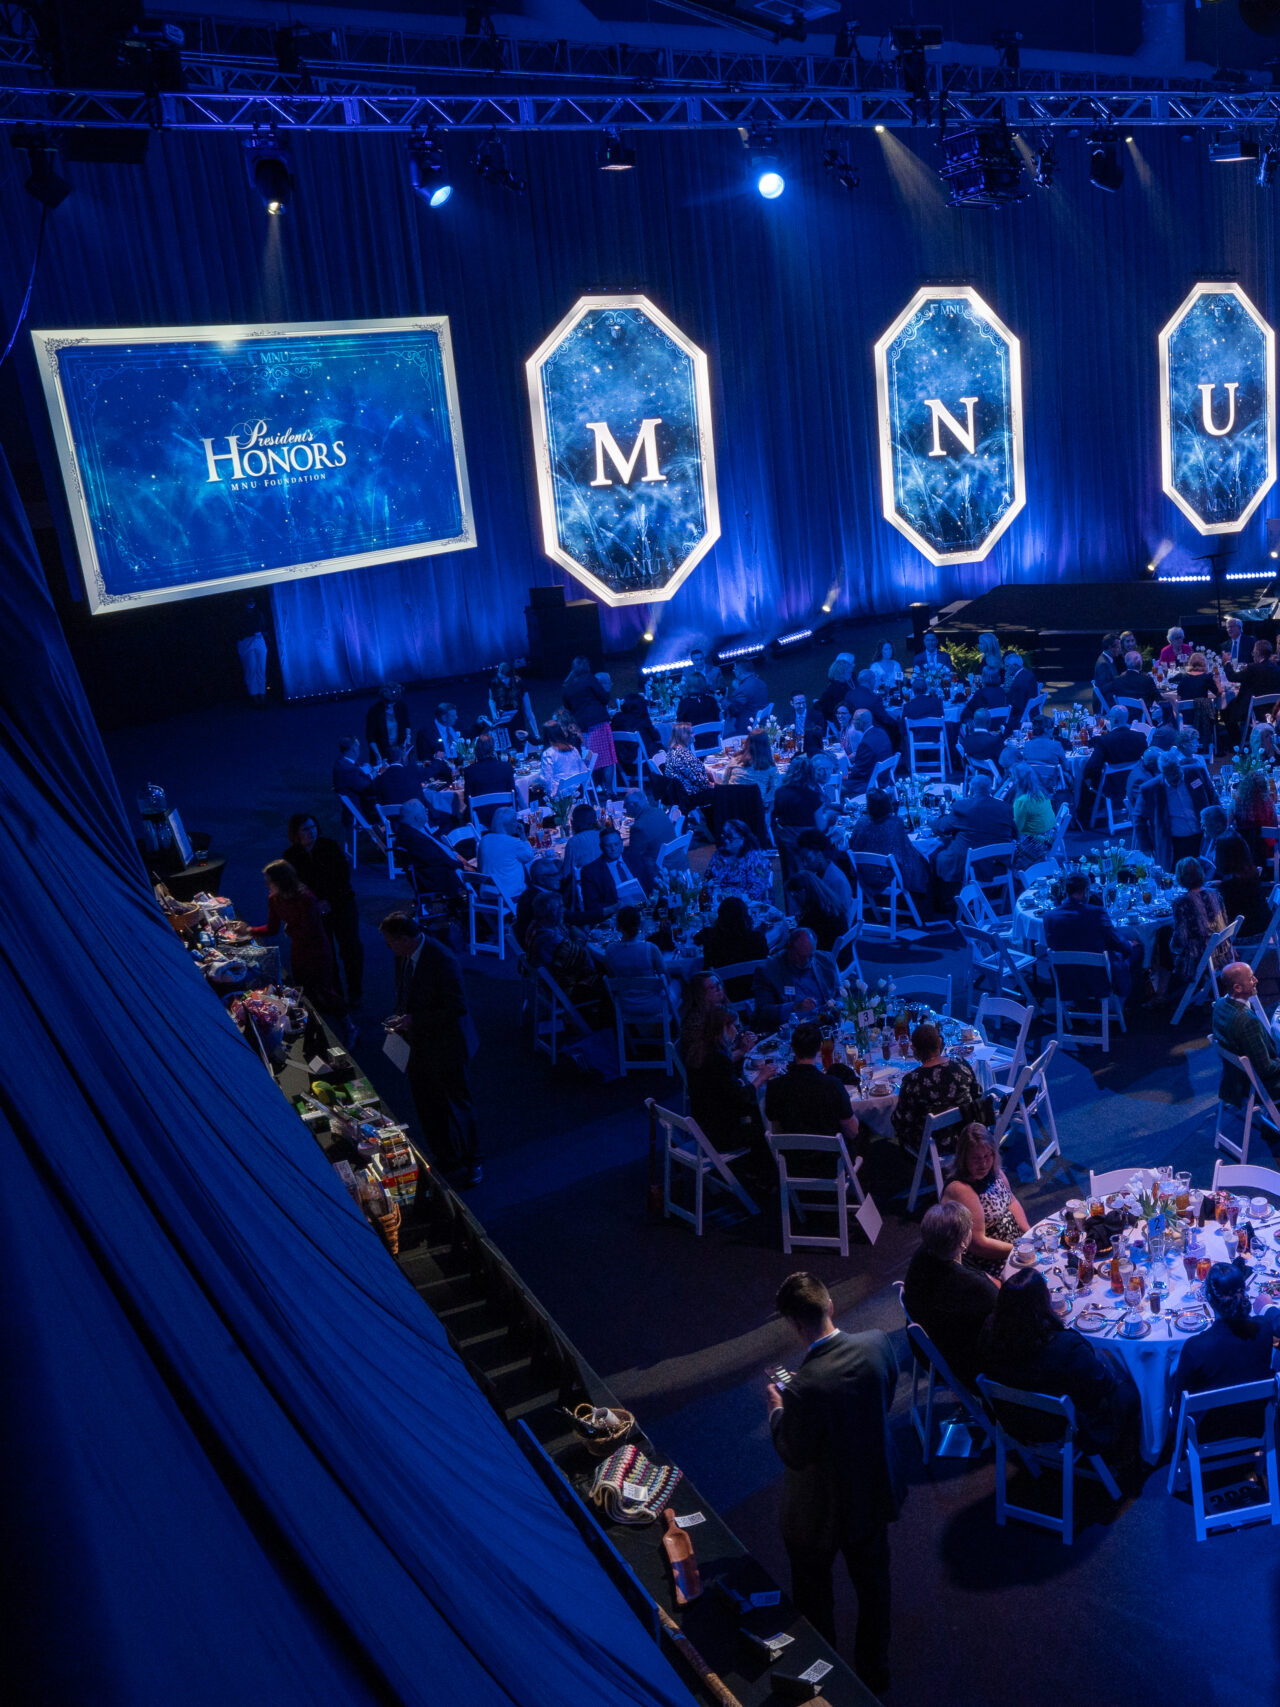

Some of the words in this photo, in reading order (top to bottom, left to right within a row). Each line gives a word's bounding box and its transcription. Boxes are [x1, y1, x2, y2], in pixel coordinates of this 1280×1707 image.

[260, 352, 291, 363] MNU
[925, 397, 978, 456] N
[1197, 383, 1238, 436] U
[231, 419, 314, 449] President's
[586, 418, 666, 487] M
[202, 435, 346, 483] HONORS
[864, 1012, 869, 1022] 3
[1154, 1218, 1160, 1231] 2
